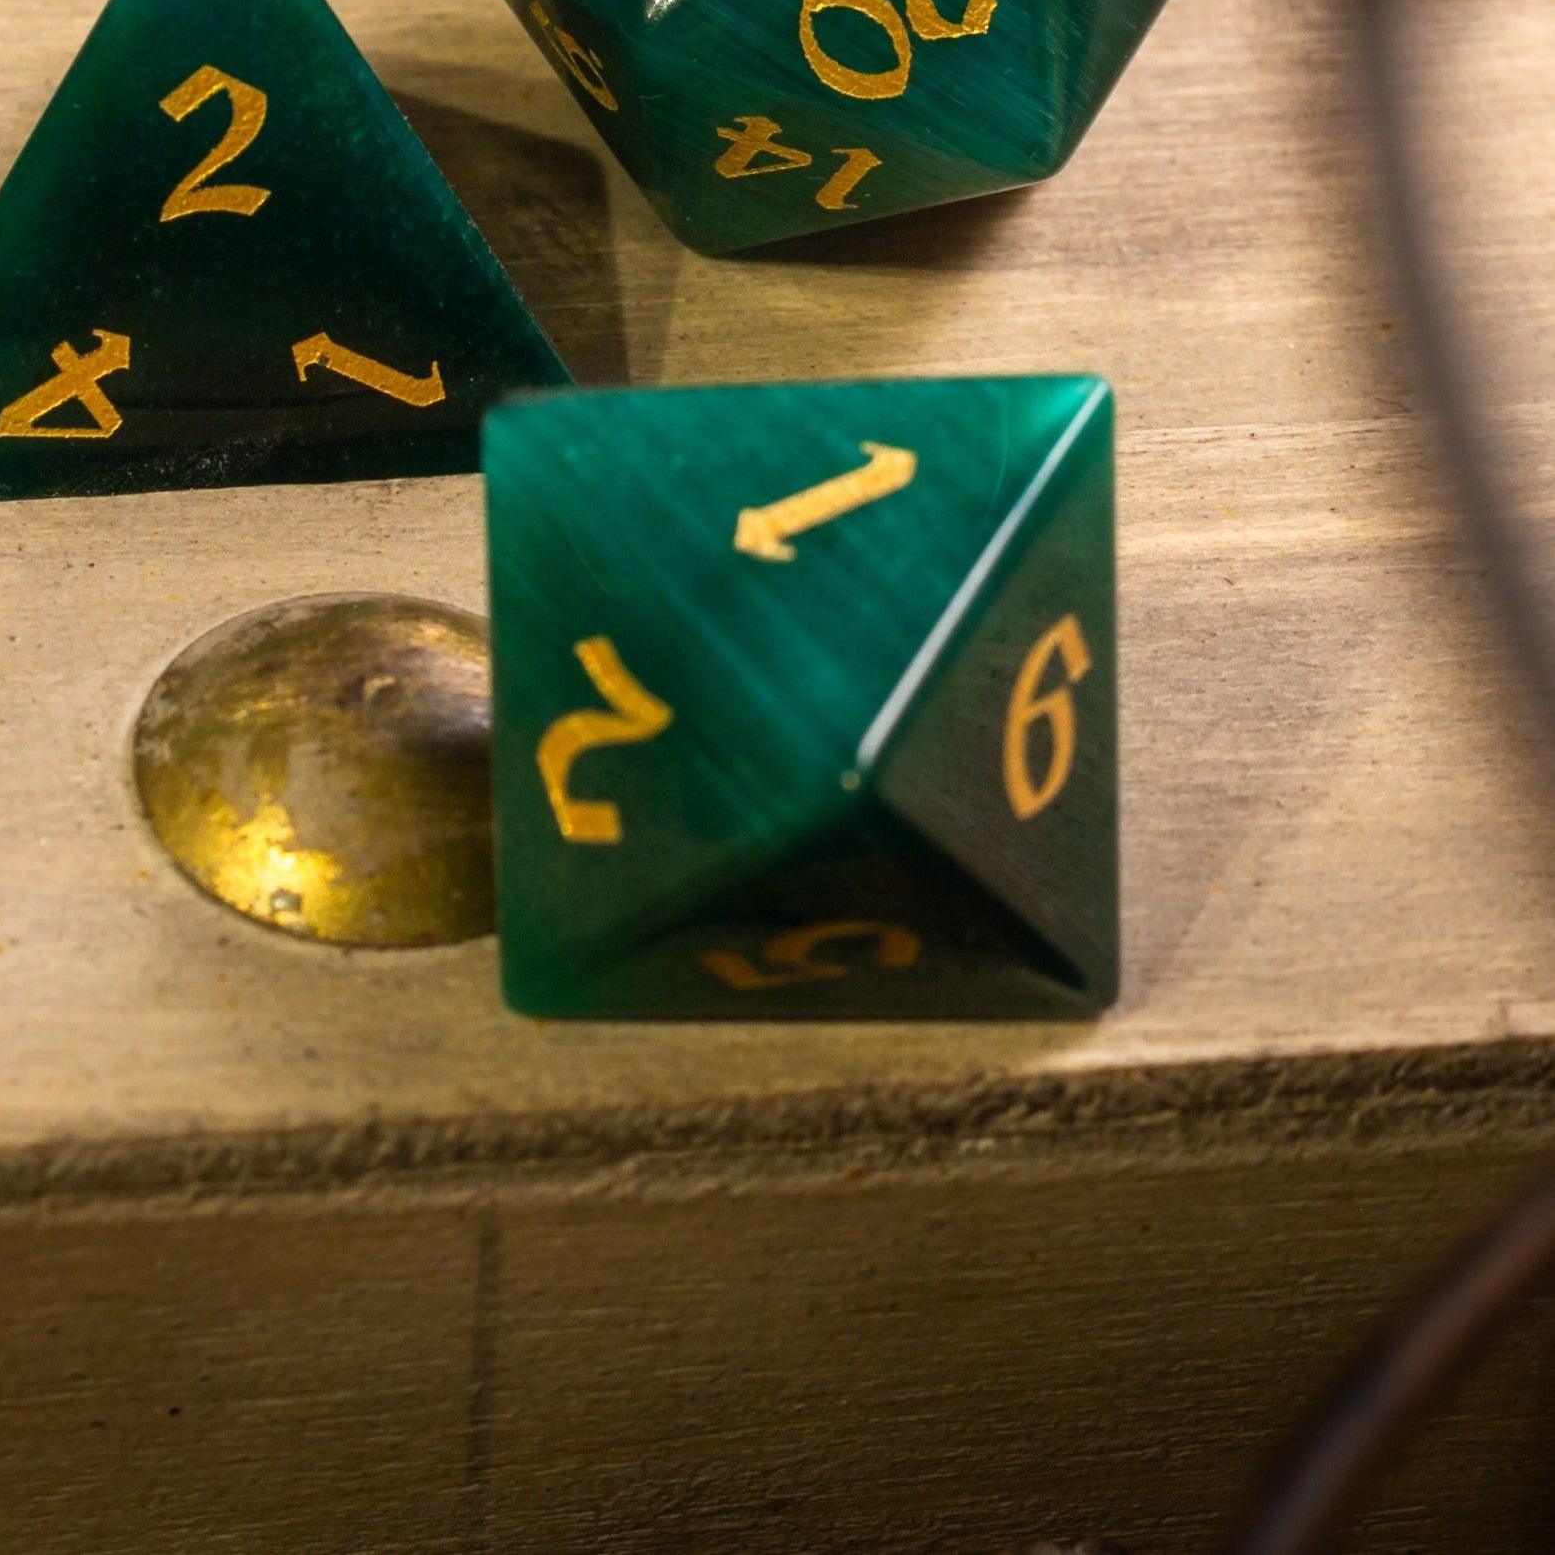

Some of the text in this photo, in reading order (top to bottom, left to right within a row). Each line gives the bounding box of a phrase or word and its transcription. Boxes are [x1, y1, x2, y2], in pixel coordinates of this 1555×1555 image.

[159, 63, 272, 223] 2
[713, 113, 883, 211] 14
[290, 331, 448, 409] 1
[733, 441, 917, 562] 1
[536, 636, 673, 843] 2
[1002, 614, 1092, 820] 6
